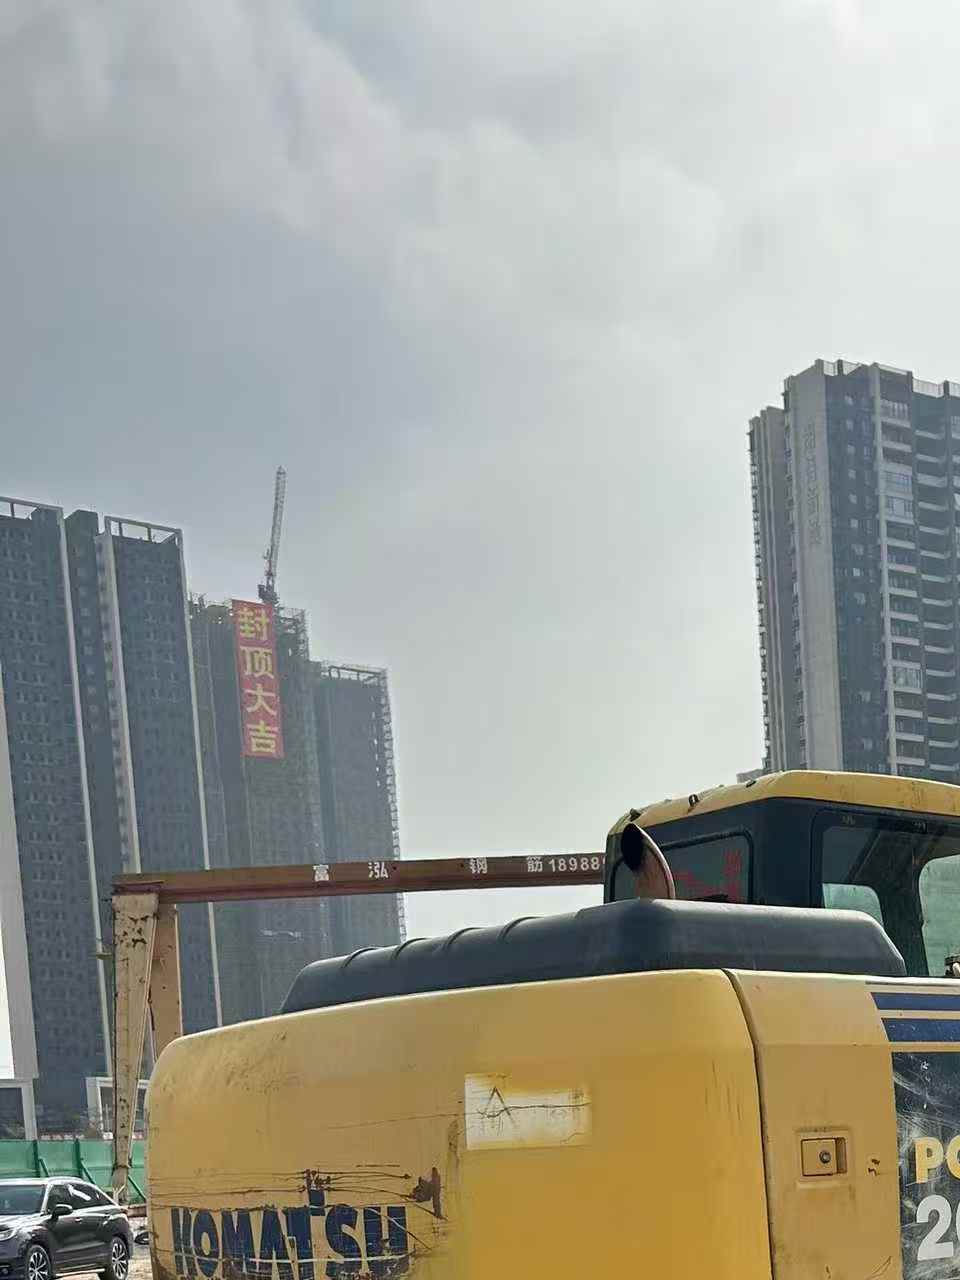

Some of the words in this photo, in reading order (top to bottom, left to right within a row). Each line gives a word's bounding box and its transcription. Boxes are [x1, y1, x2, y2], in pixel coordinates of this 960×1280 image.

[238, 607, 278, 753] 封顶大吉
[548, 856, 605, 873] 18988
